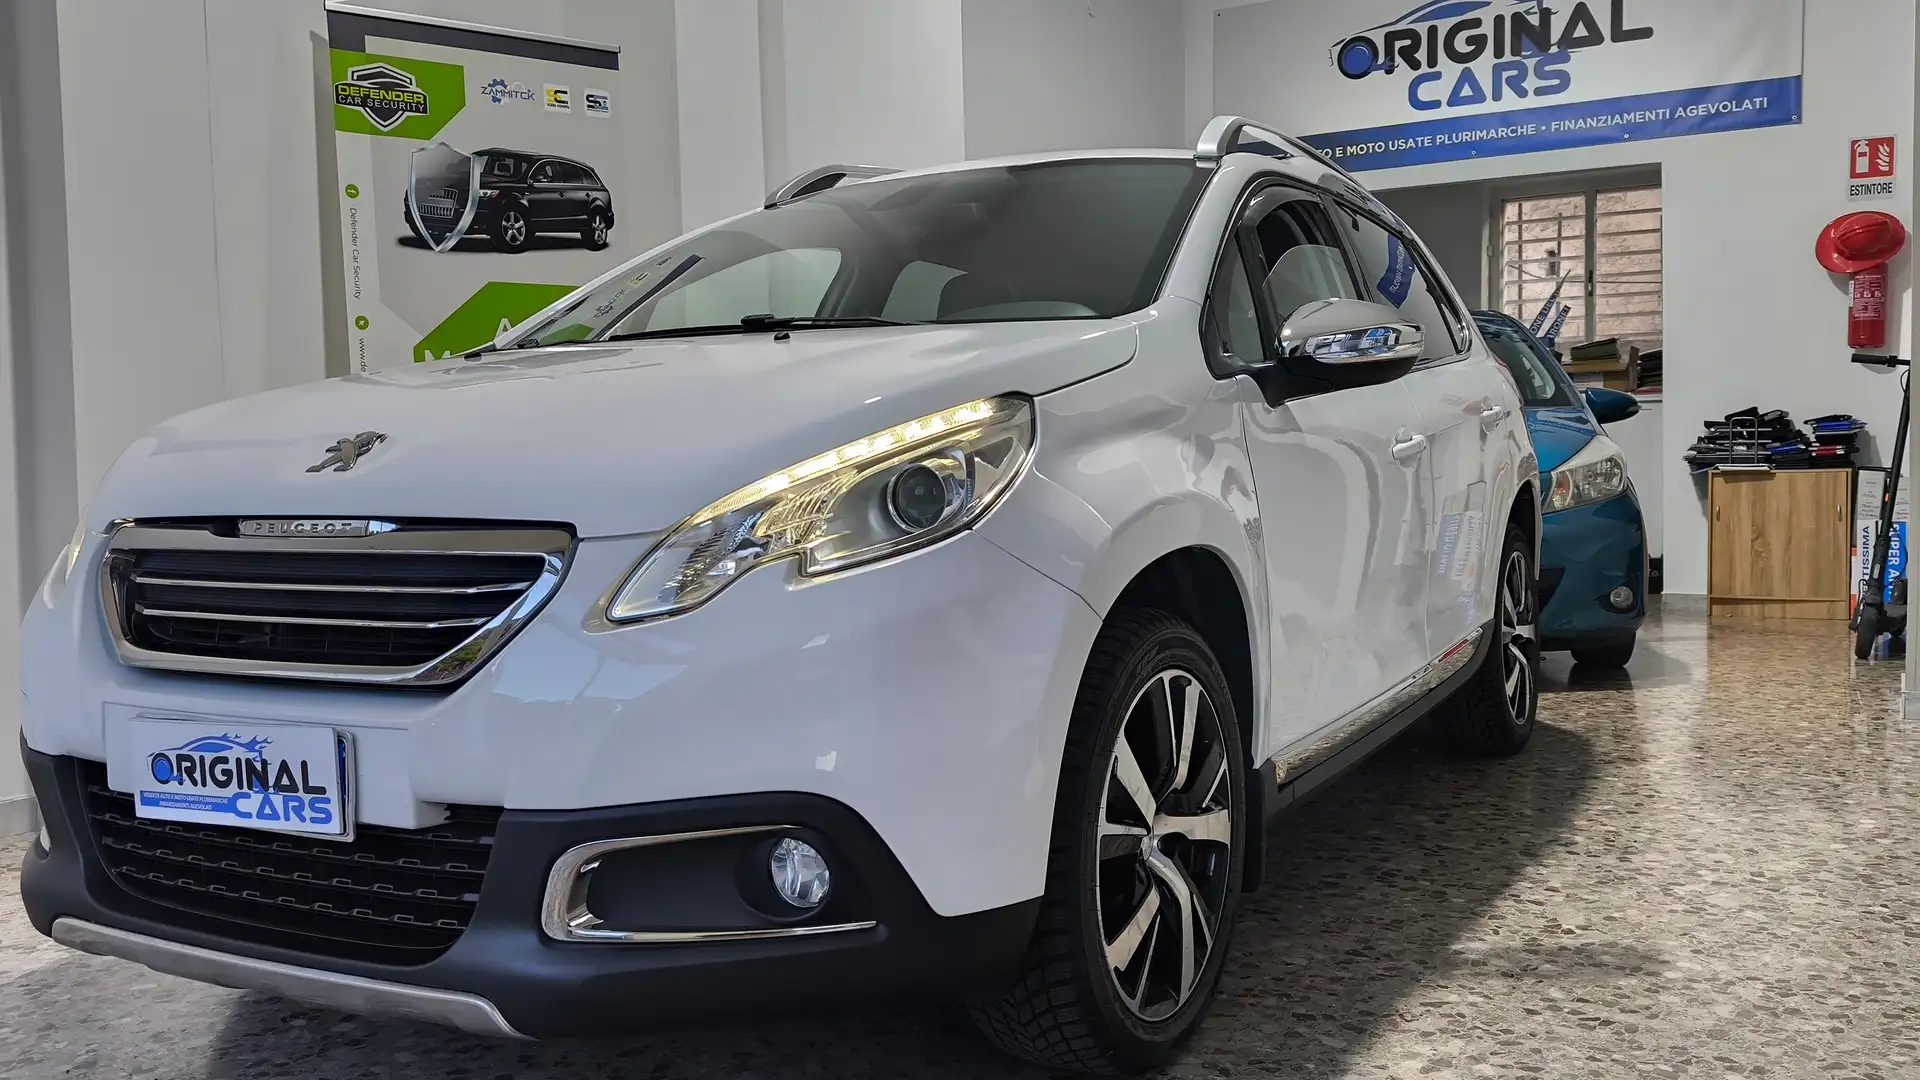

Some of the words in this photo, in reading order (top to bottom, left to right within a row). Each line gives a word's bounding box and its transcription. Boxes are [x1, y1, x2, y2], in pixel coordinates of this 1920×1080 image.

[1337, 0, 1654, 80] ORIGINAL
[338, 85, 424, 104] DEFENDER
[1408, 51, 1571, 111] CARS
[339, 95, 361, 105] CAR
[367, 98, 425, 112] SECURITY
[1335, 147, 1344, 158] E
[1347, 141, 1385, 156] MOTO
[1389, 136, 1433, 151] USATE
[1436, 124, 1537, 145] PLURIMARCHE
[1551, 108, 1670, 132] FINANZIAMENTI
[1675, 97, 1768, 119] AGEVOLATI
[1850, 182, 1893, 197] ESTINTORE
[350, 207, 359, 247] Defender
[353, 265, 362, 300] Security
[253, 522, 352, 535] PEUGEOT
[151, 752, 328, 795] ORIGINAL
[231, 791, 332, 825] CARS
